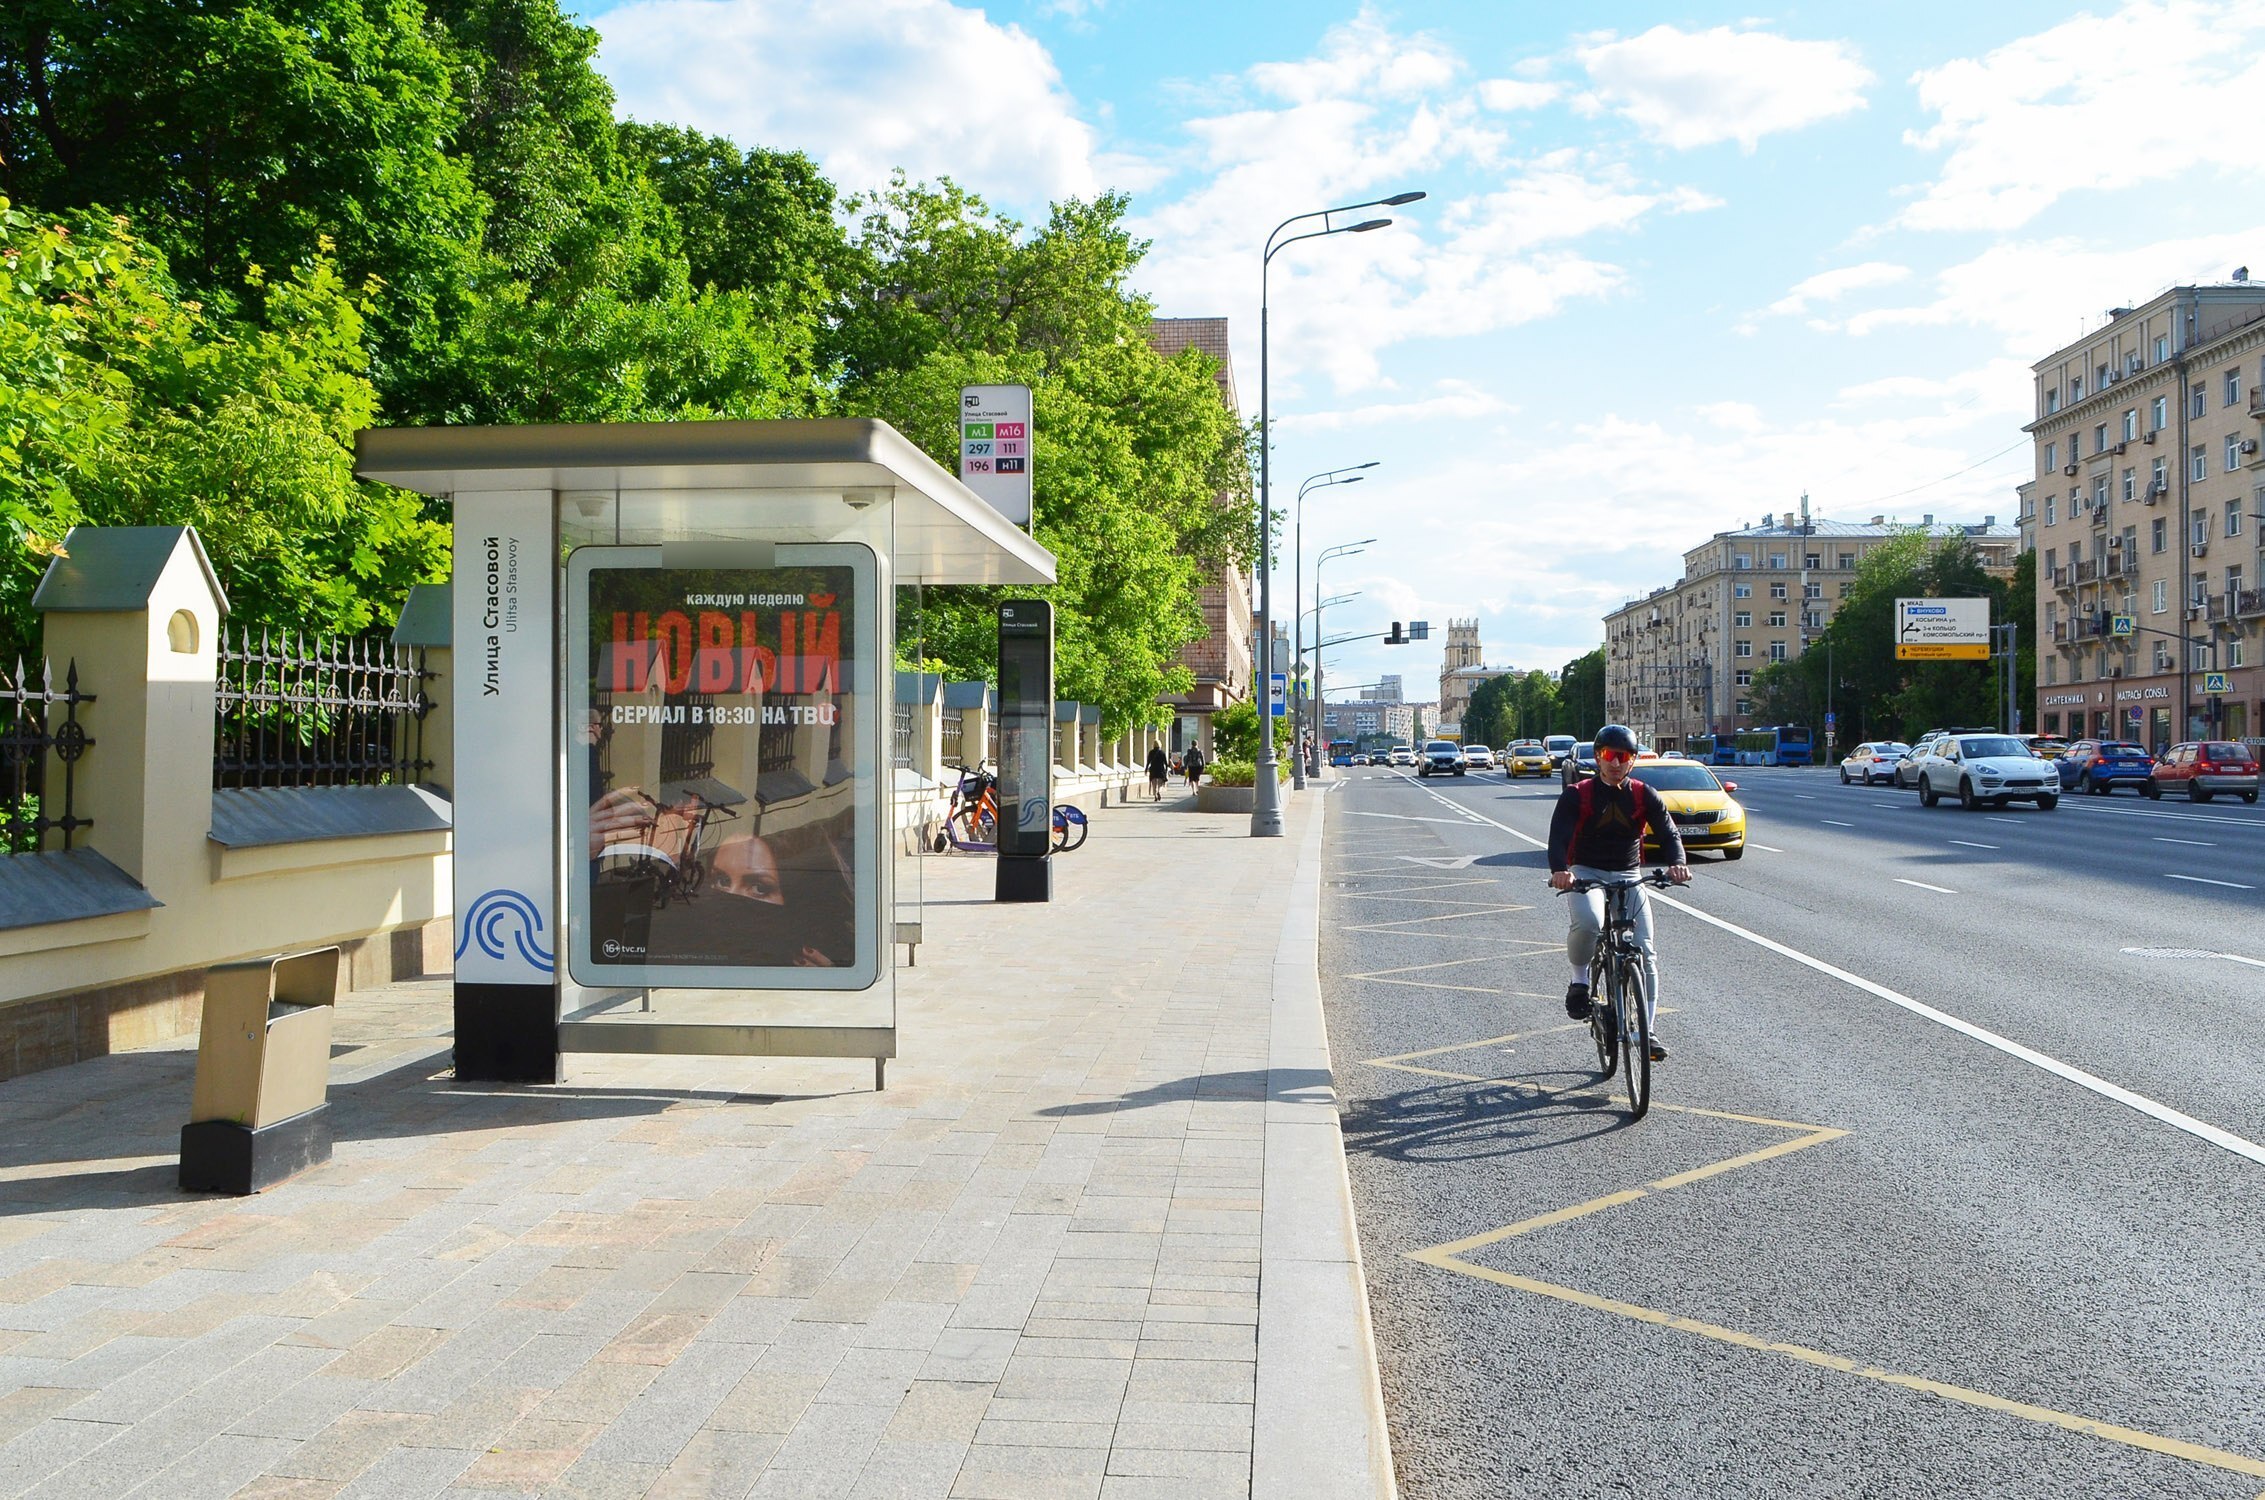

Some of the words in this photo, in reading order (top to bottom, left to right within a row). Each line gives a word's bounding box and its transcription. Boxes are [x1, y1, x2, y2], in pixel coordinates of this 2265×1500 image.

[999, 425, 1021, 436] м16
[969, 444, 990, 454] 297
[1003, 443, 1017, 453] 111
[969, 461, 989, 471] 196
[506, 537, 520, 593] Stasovoy
[483, 537, 499, 629] Стасовой
[686, 593, 744, 607] каждую
[749, 593, 804, 606] неделю
[506, 597, 517, 633] Ulitsa
[612, 592, 840, 694] НОВЫЙ
[483, 635, 501, 696] Улица
[2046, 694, 2085, 705] САНТЕХНИКА
[2117, 689, 2142, 701] МАТРАСЫ
[2144, 687, 2169, 699] CONSUL
[612, 706, 685, 724] СЕРИАЛ
[691, 707, 704, 724] В
[706, 707, 755, 724] 18:30
[762, 707, 786, 724] НА
[792, 706, 837, 726] ТВЦ
[605, 944, 620, 953] 16+
[621, 945, 646, 953] tvc.ru
